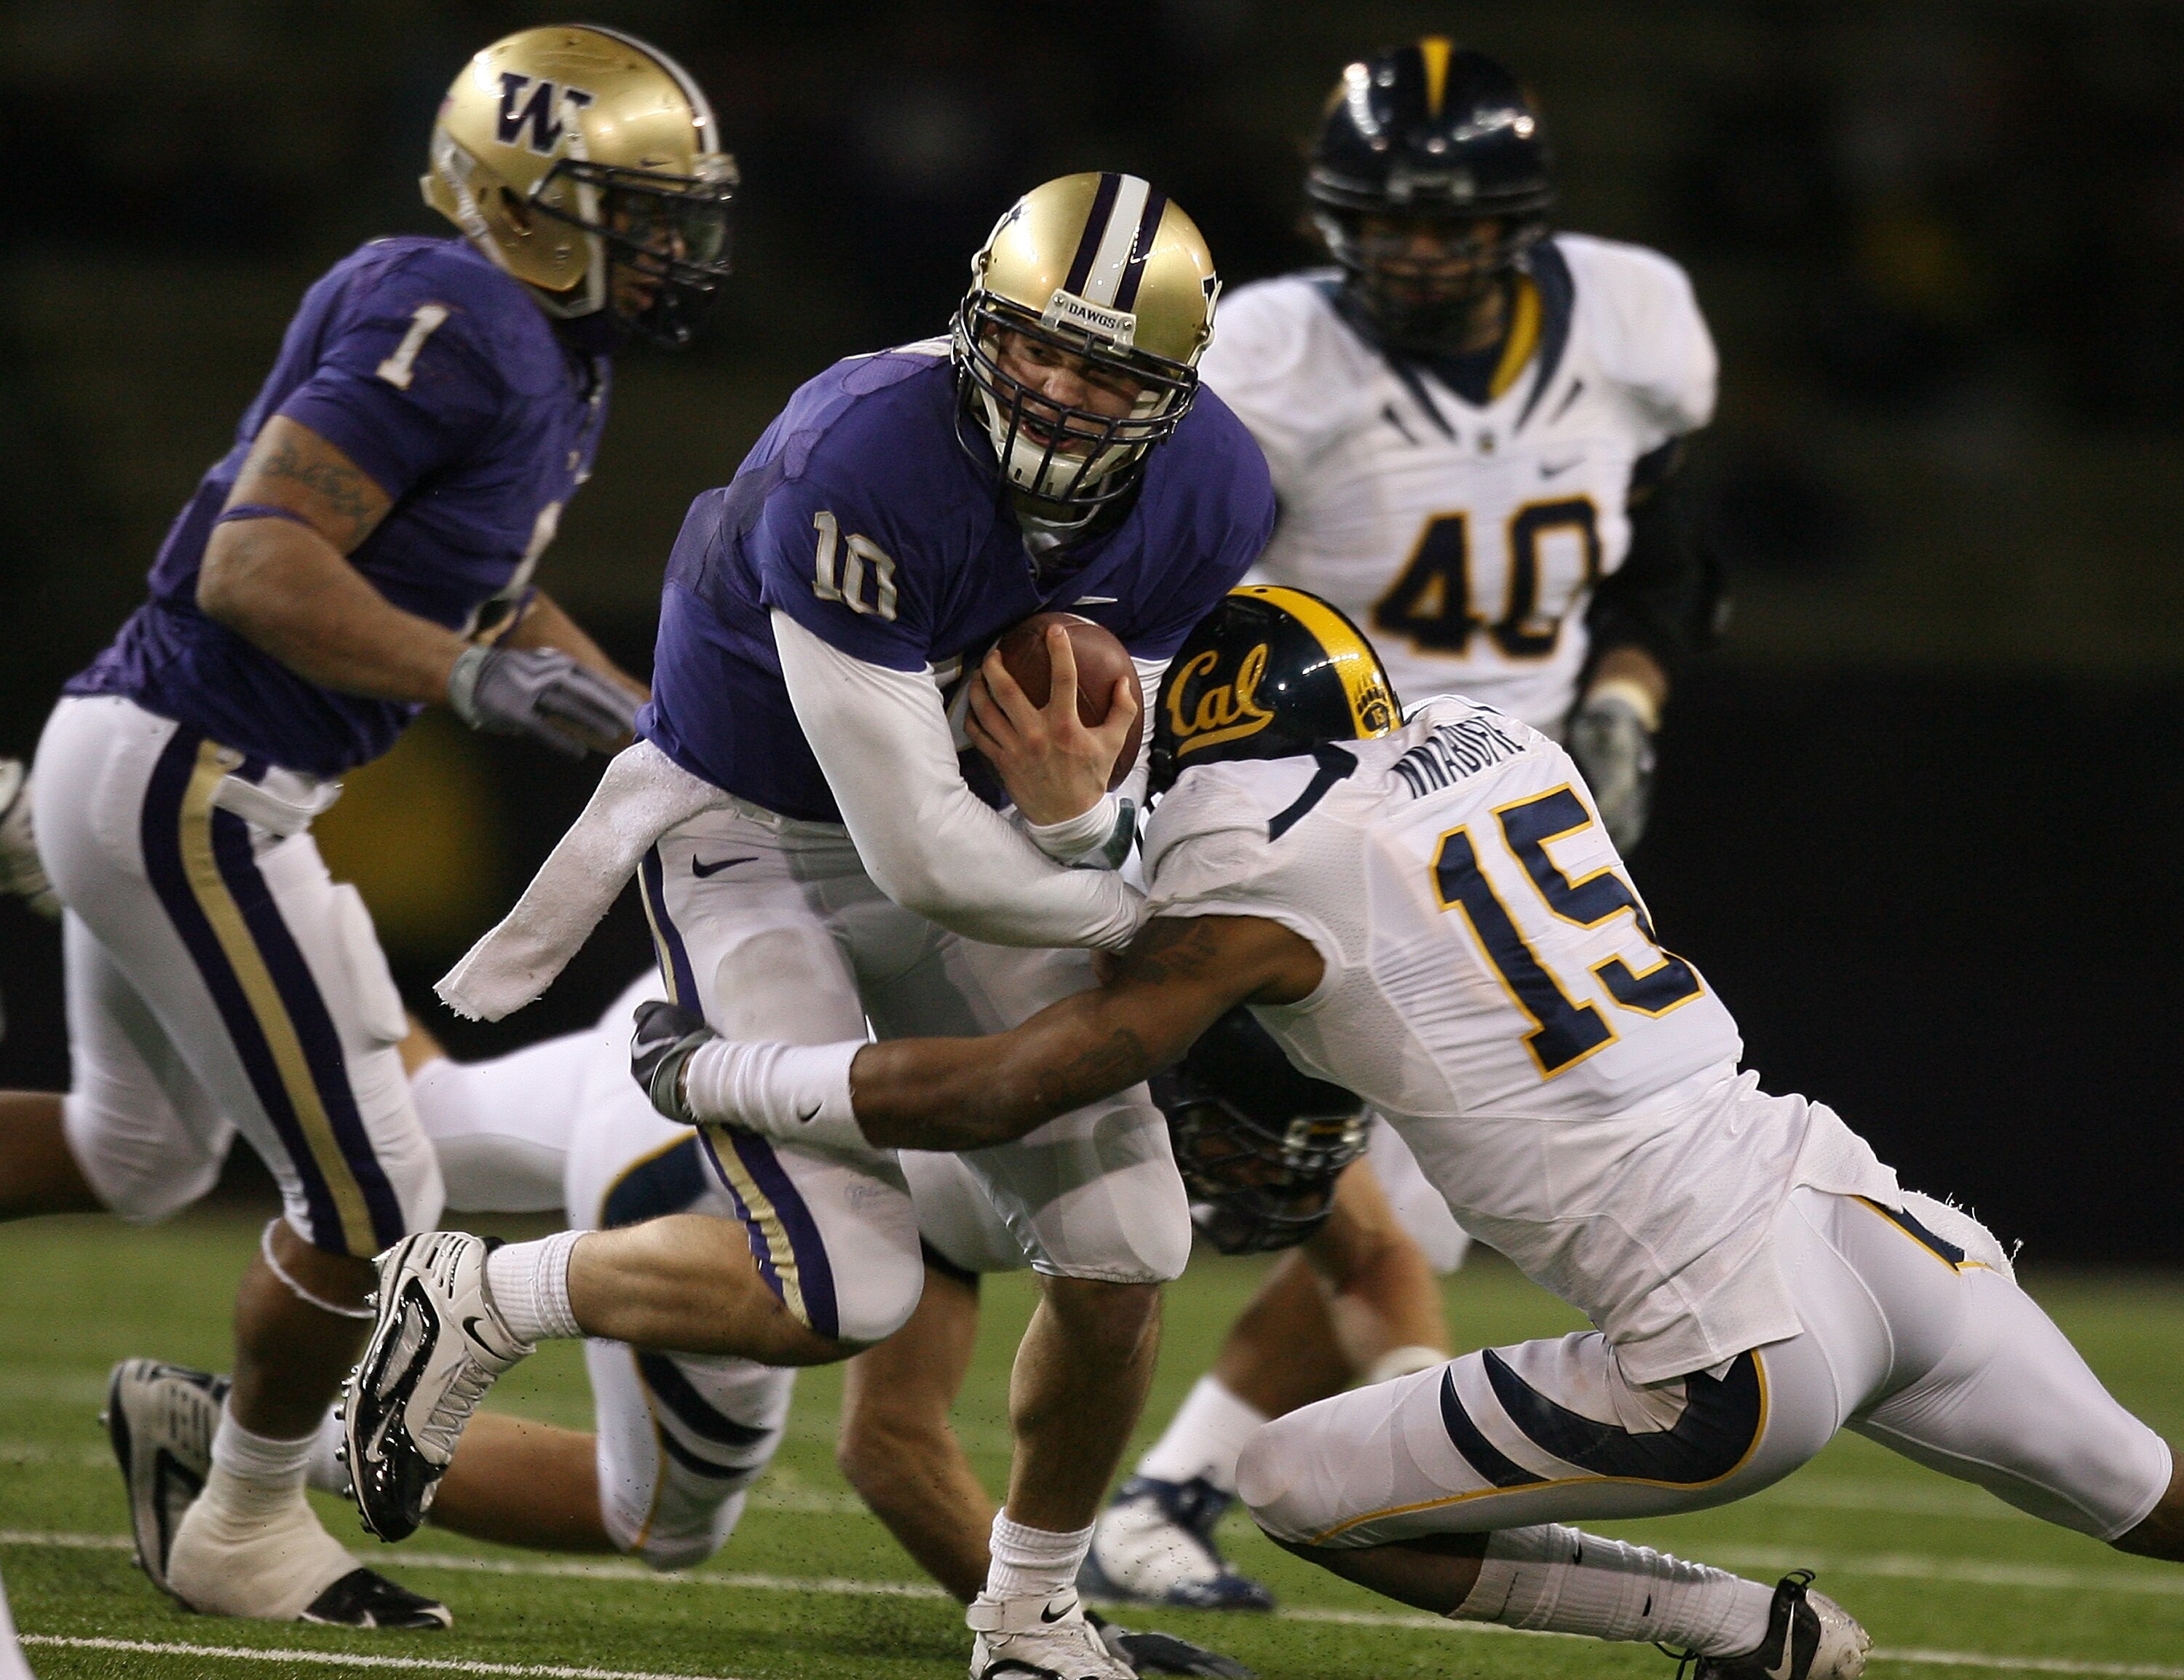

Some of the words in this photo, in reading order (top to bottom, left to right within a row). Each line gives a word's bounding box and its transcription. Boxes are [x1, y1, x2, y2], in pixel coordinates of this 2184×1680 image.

[494, 71, 597, 157] W
[376, 305, 451, 391] 1
[1068, 302, 1117, 329] DAWGS
[812, 511, 898, 621] 10
[1369, 493, 1603, 663] 40
[1166, 643, 1275, 757] Cal
[1429, 782, 1706, 1082] 15
